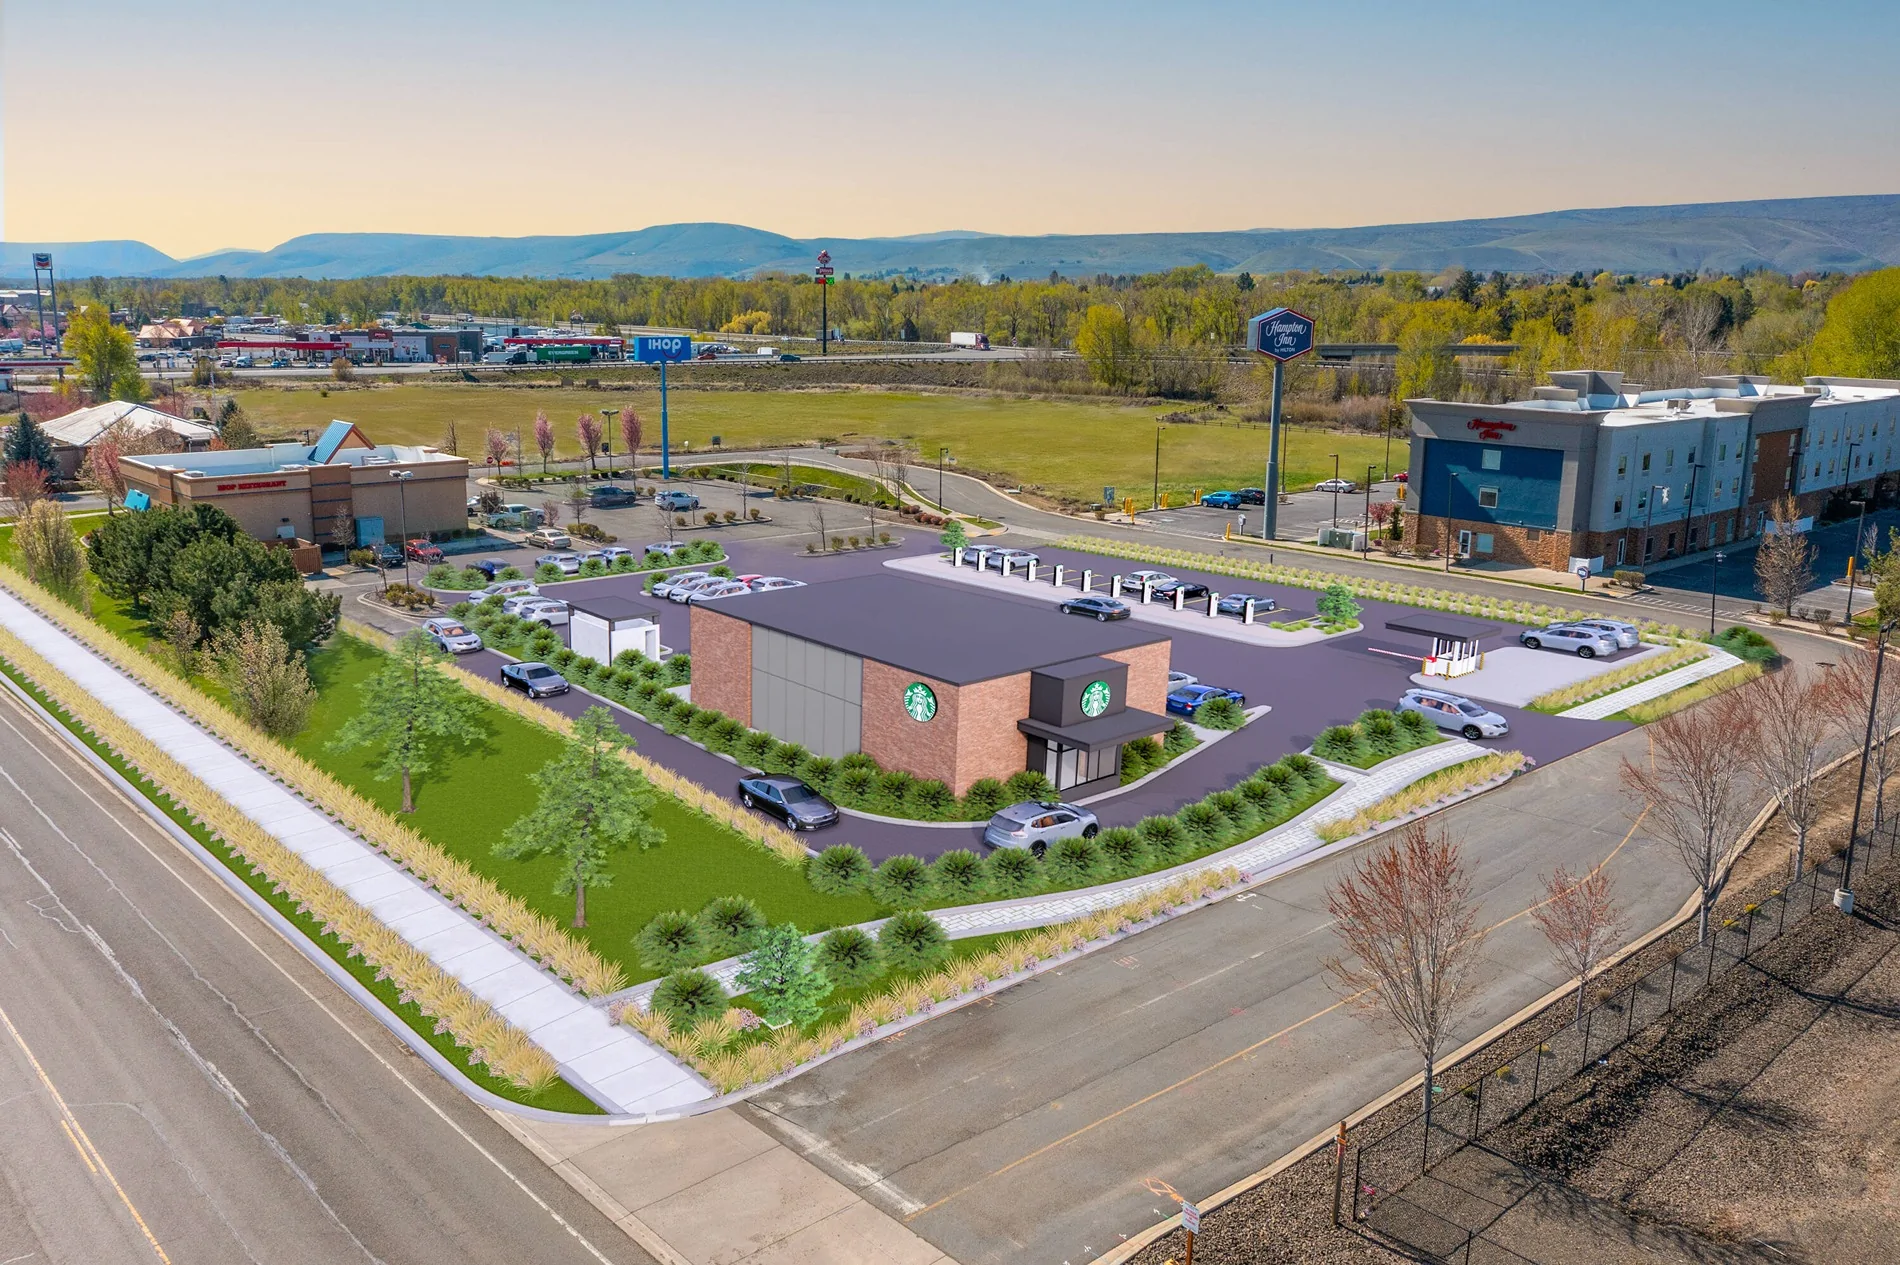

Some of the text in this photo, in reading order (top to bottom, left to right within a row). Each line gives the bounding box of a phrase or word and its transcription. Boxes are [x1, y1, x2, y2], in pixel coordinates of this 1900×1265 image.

[1266, 320, 1306, 336] Hampton
[648, 338, 682, 354] IHOP
[1274, 333, 1297, 347] Inn
[238, 480, 287, 490] RESTAURANT
